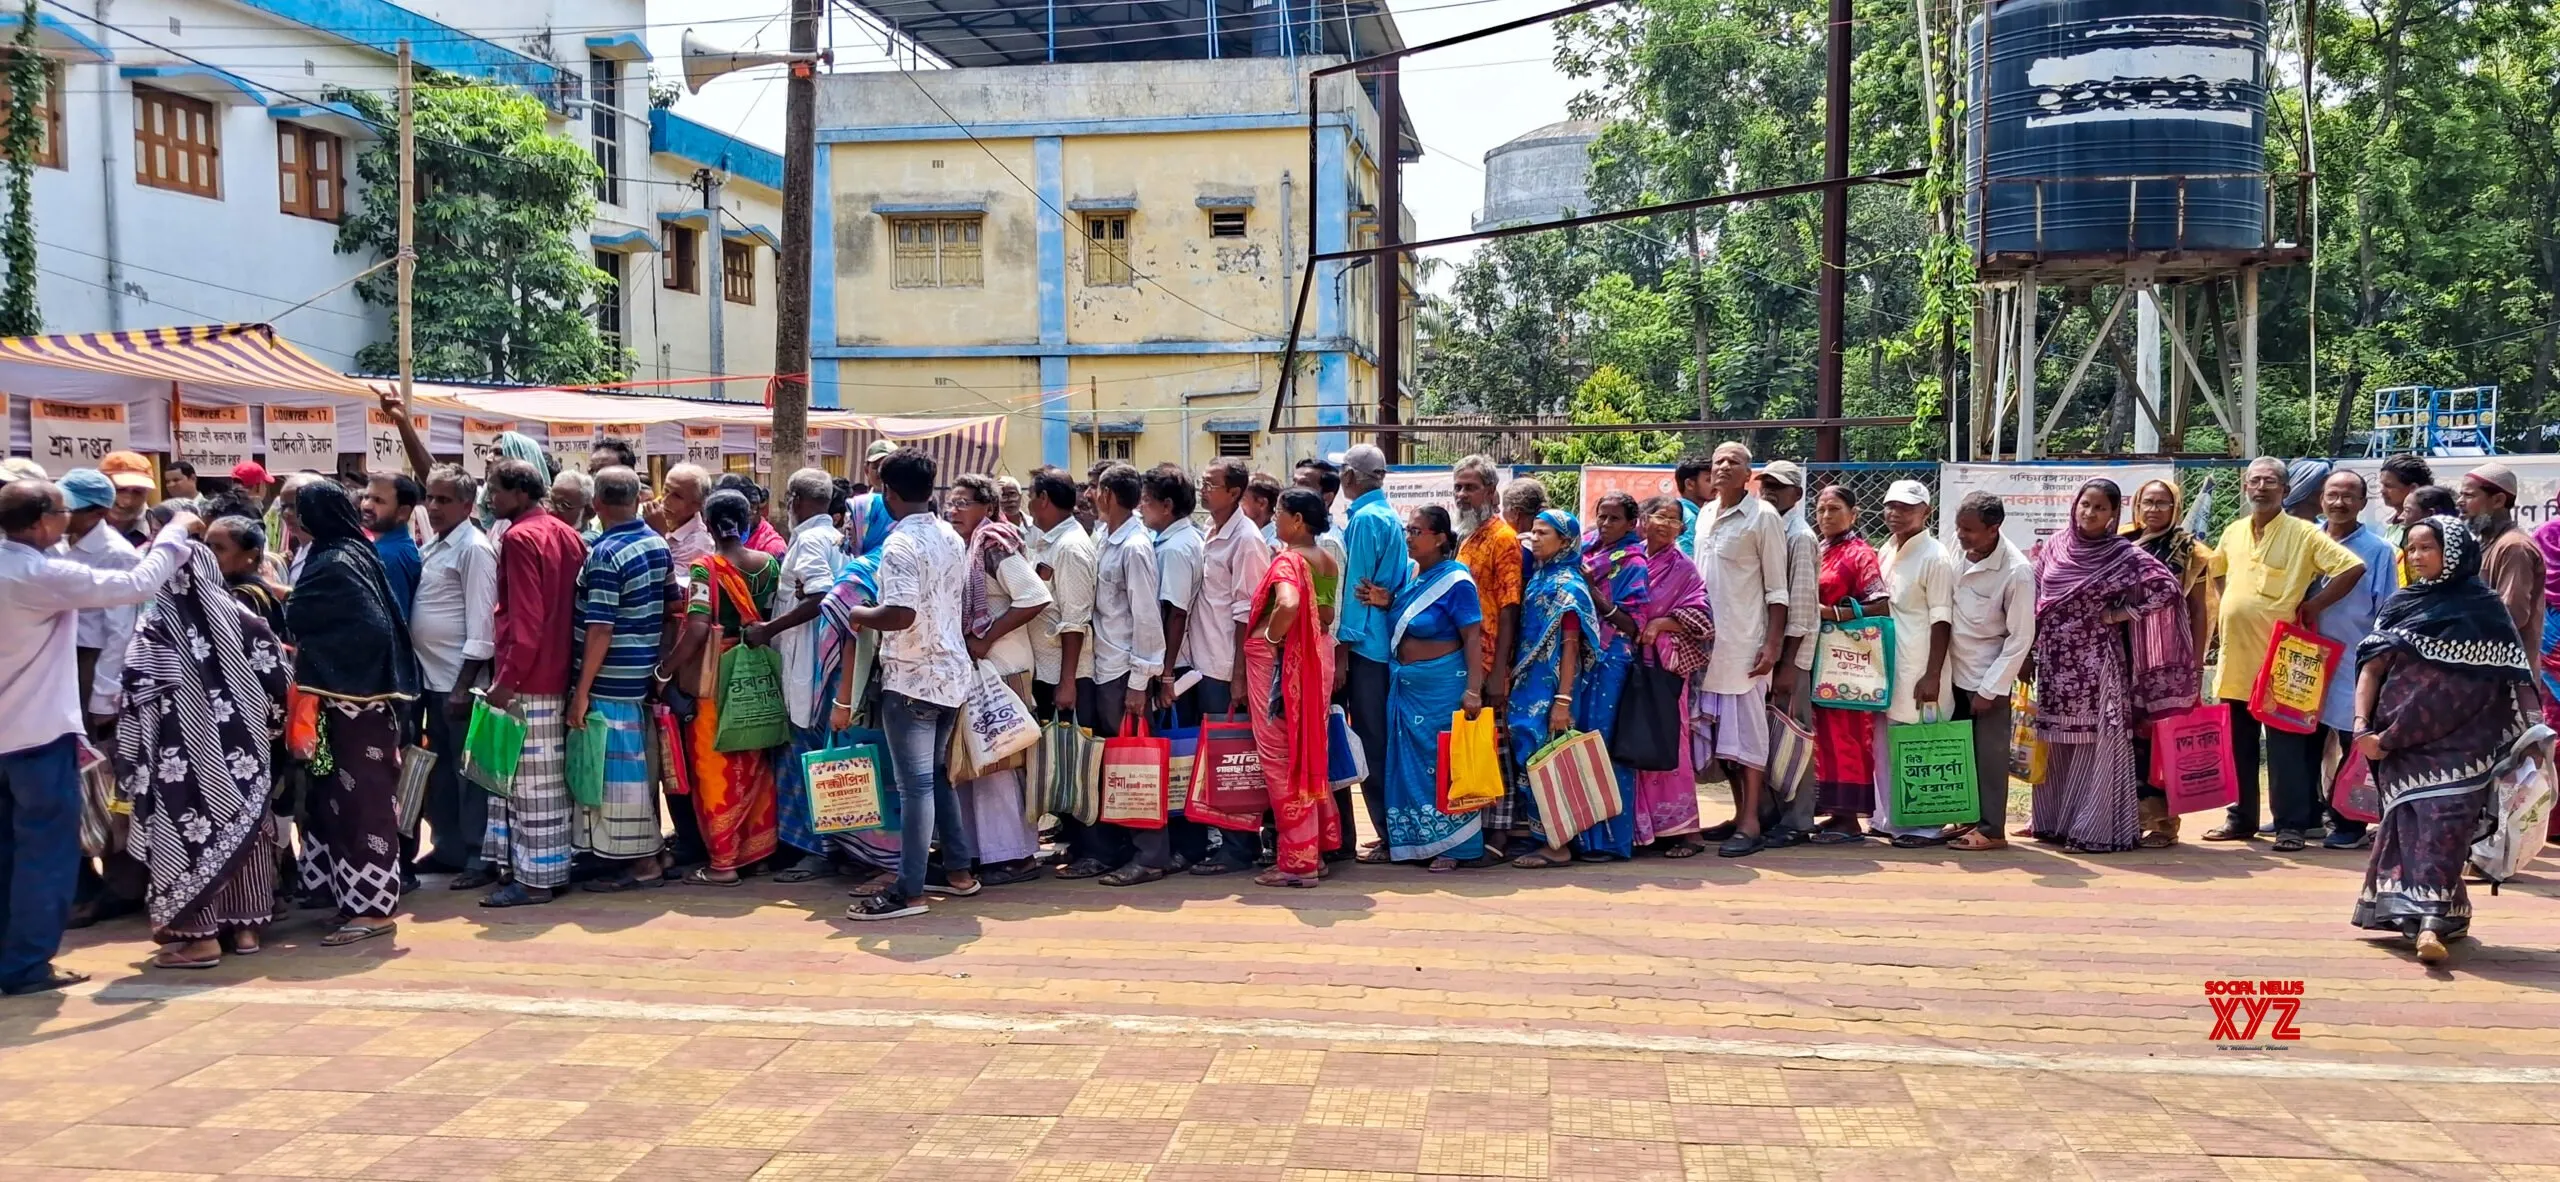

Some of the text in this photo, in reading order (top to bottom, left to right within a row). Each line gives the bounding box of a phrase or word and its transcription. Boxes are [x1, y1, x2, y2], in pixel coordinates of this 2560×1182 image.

[181, 407, 220, 419] COUNTER
[230, 410, 236, 419] 2
[273, 409, 309, 421] COUNTER
[317, 410, 328, 421] 17
[48, 435, 73, 459] শ্রম
[270, 431, 333, 455] আদিবাসী উন্নয়ন
[372, 430, 393, 462] ভূমি
[687, 441, 719, 463] কৃষি দপ্তর
[1389, 491, 1435, 499] Government's
[2002, 494, 2074, 506] নকল্যাণ
[1918, 781, 1965, 793] বস্ত্রালয়
